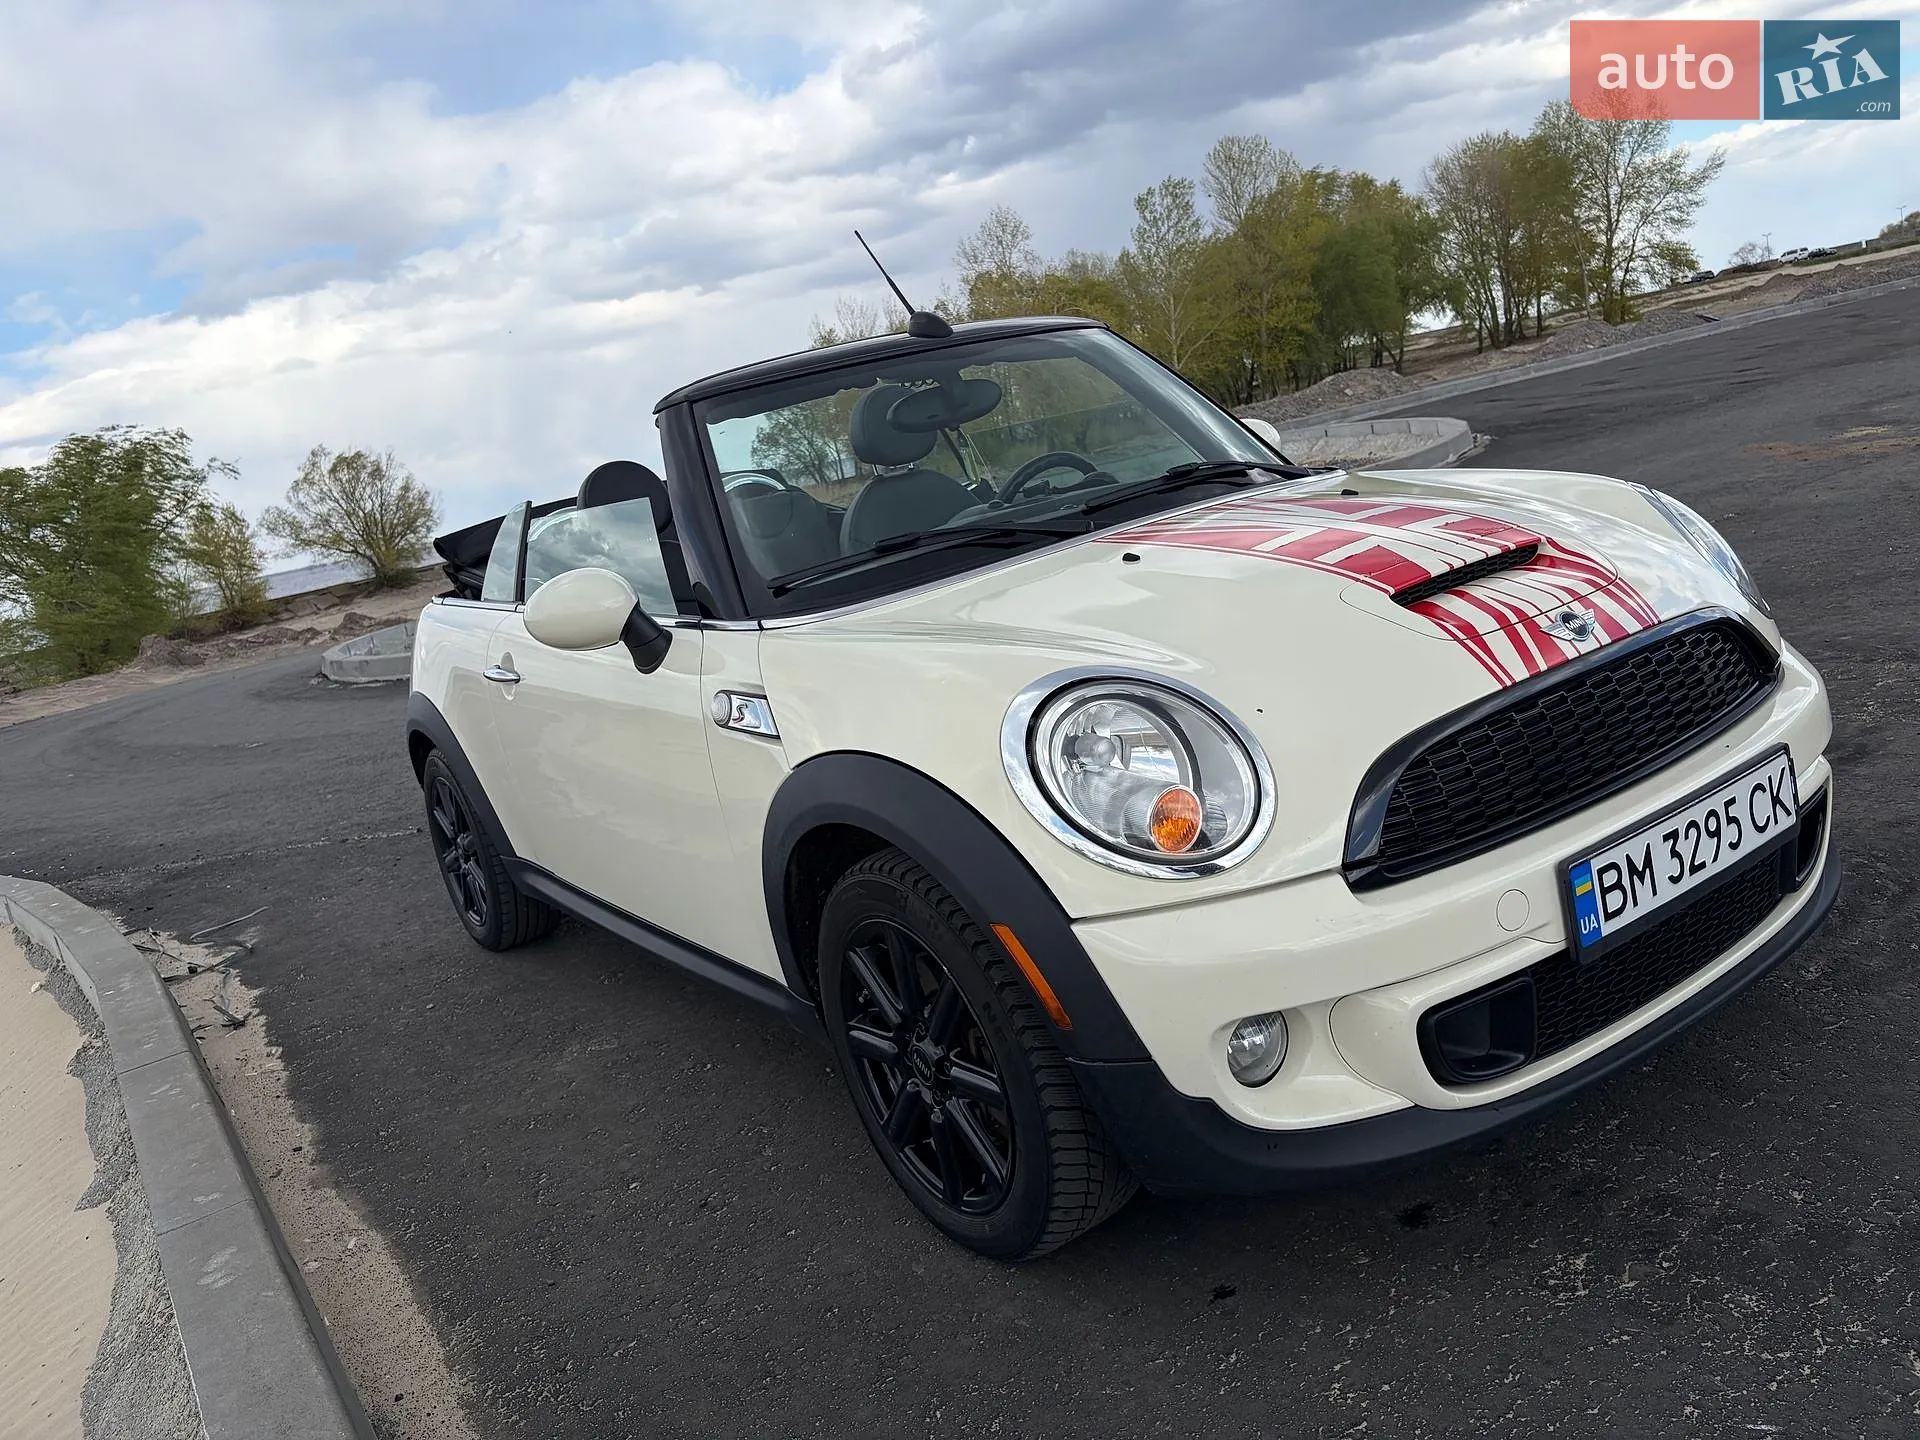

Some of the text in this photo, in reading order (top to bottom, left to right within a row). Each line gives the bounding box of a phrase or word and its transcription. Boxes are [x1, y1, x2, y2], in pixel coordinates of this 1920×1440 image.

[1564, 617, 1585, 631] MINI
[731, 703, 748, 724] S
[1596, 766, 1793, 923] BM 3295 CK
[1580, 915, 1599, 935] UA
[913, 1052, 930, 1079] MINI
